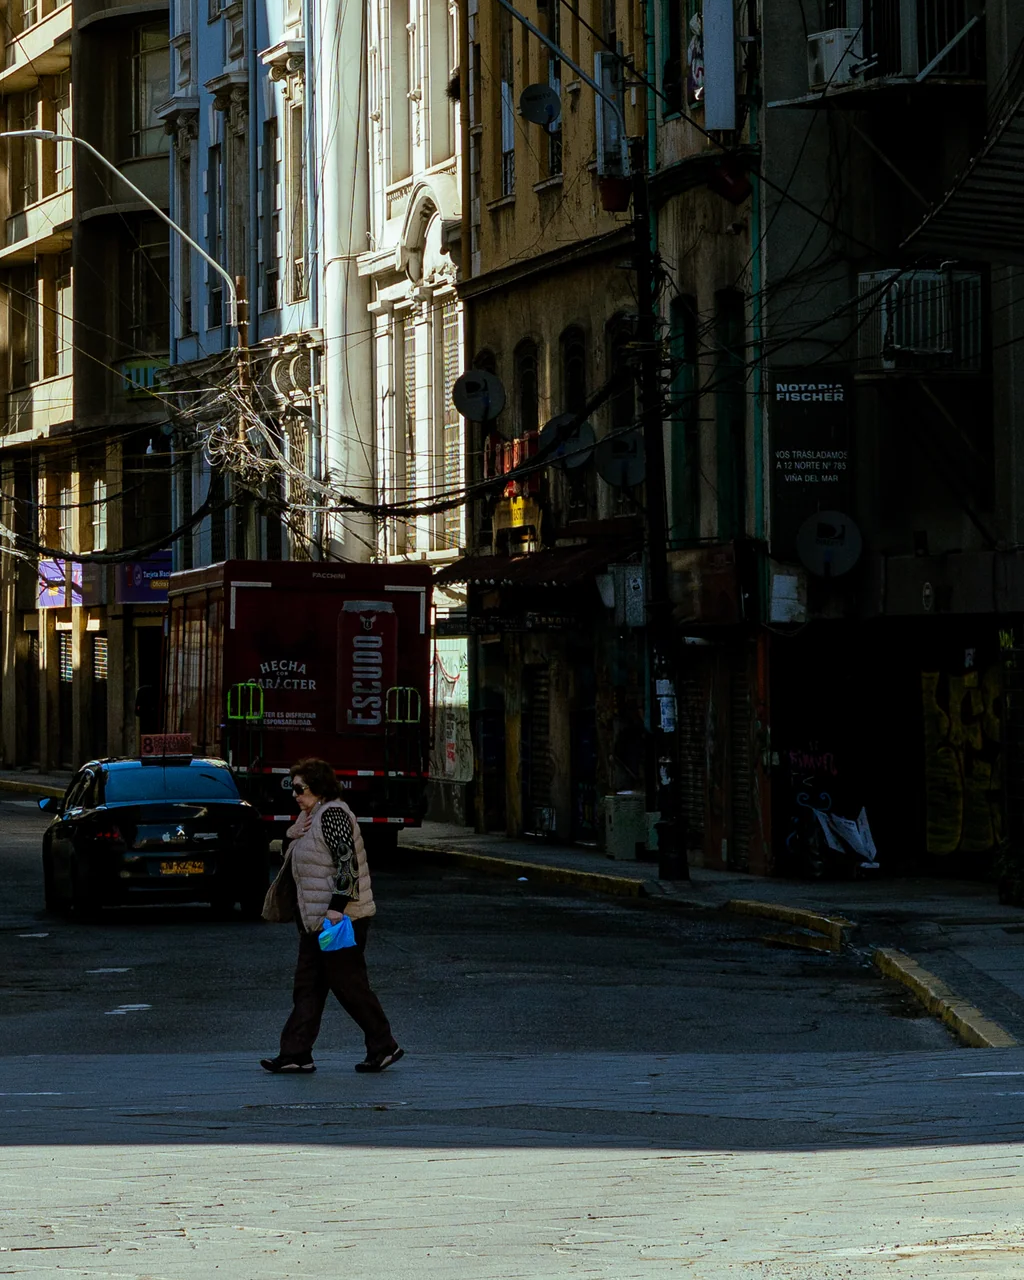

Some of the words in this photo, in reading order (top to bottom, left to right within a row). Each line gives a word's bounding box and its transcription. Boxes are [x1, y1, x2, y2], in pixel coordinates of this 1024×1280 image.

[776, 392, 844, 402] FISCHER
[792, 450, 848, 460] TRASLADAMOS
[776, 461, 782, 470] A
[784, 461, 793, 470] 12
[794, 461, 820, 470] NORTE
[833, 461, 847, 470] 785
[784, 472, 803, 482] VIÑA
[804, 474, 819, 483] DEL
[821, 474, 839, 482] MAR
[260, 660, 307, 675] HECHA
[347, 635, 383, 726] ESCUDO
[143, 737, 154, 753] 8
